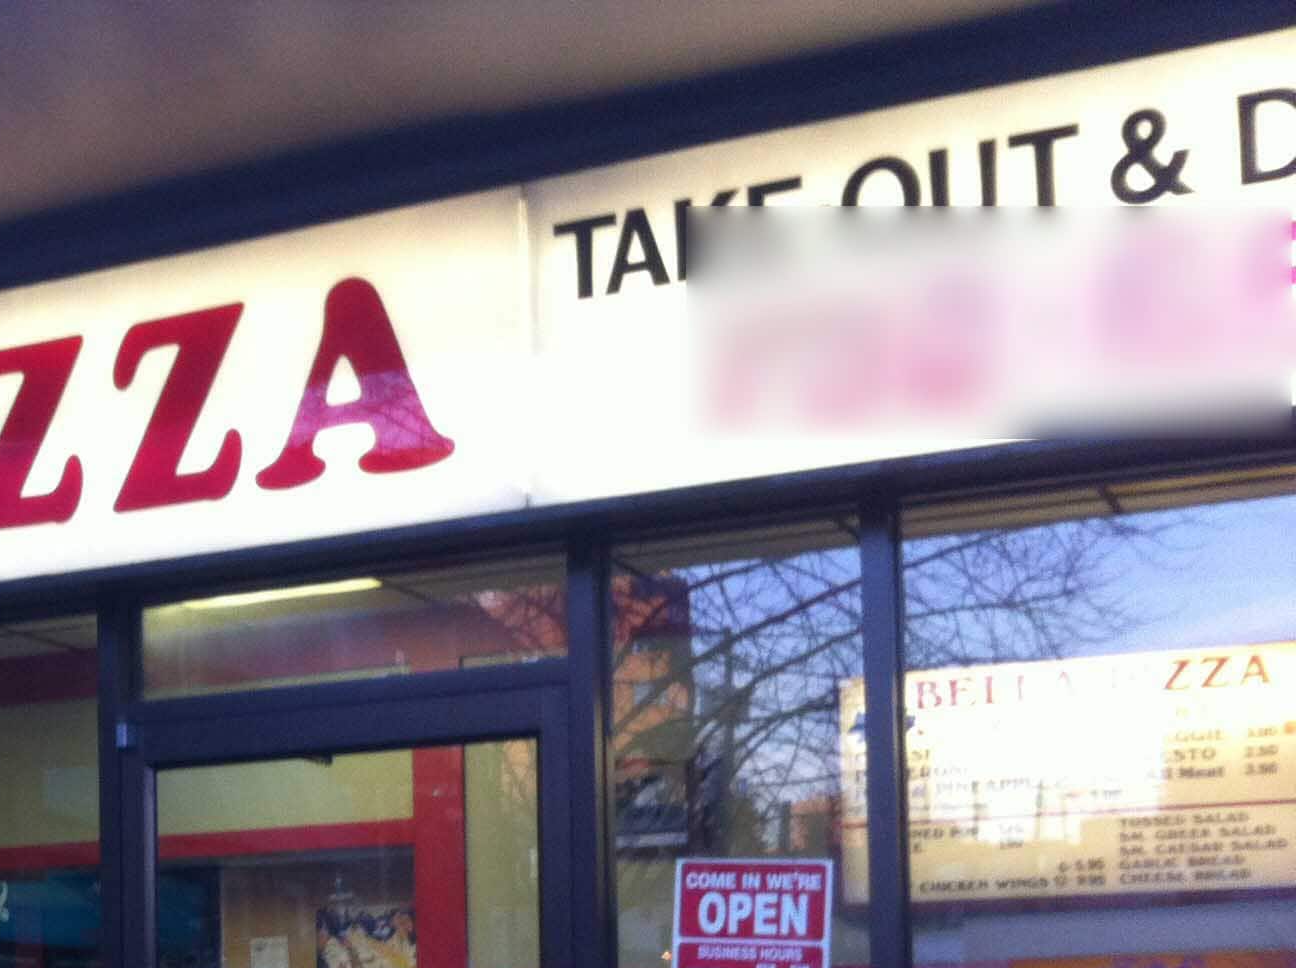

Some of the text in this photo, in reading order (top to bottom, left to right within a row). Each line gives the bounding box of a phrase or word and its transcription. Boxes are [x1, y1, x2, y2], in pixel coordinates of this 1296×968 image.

[1109, 108, 1195, 205] &
[1192, 811, 1250, 824] SALAD
[1218, 824, 1277, 837] SALAD
[1231, 838, 1288, 850] SALAD
[686, 871, 823, 891] COME IN WE'RE
[697, 891, 808, 937] OPEN
